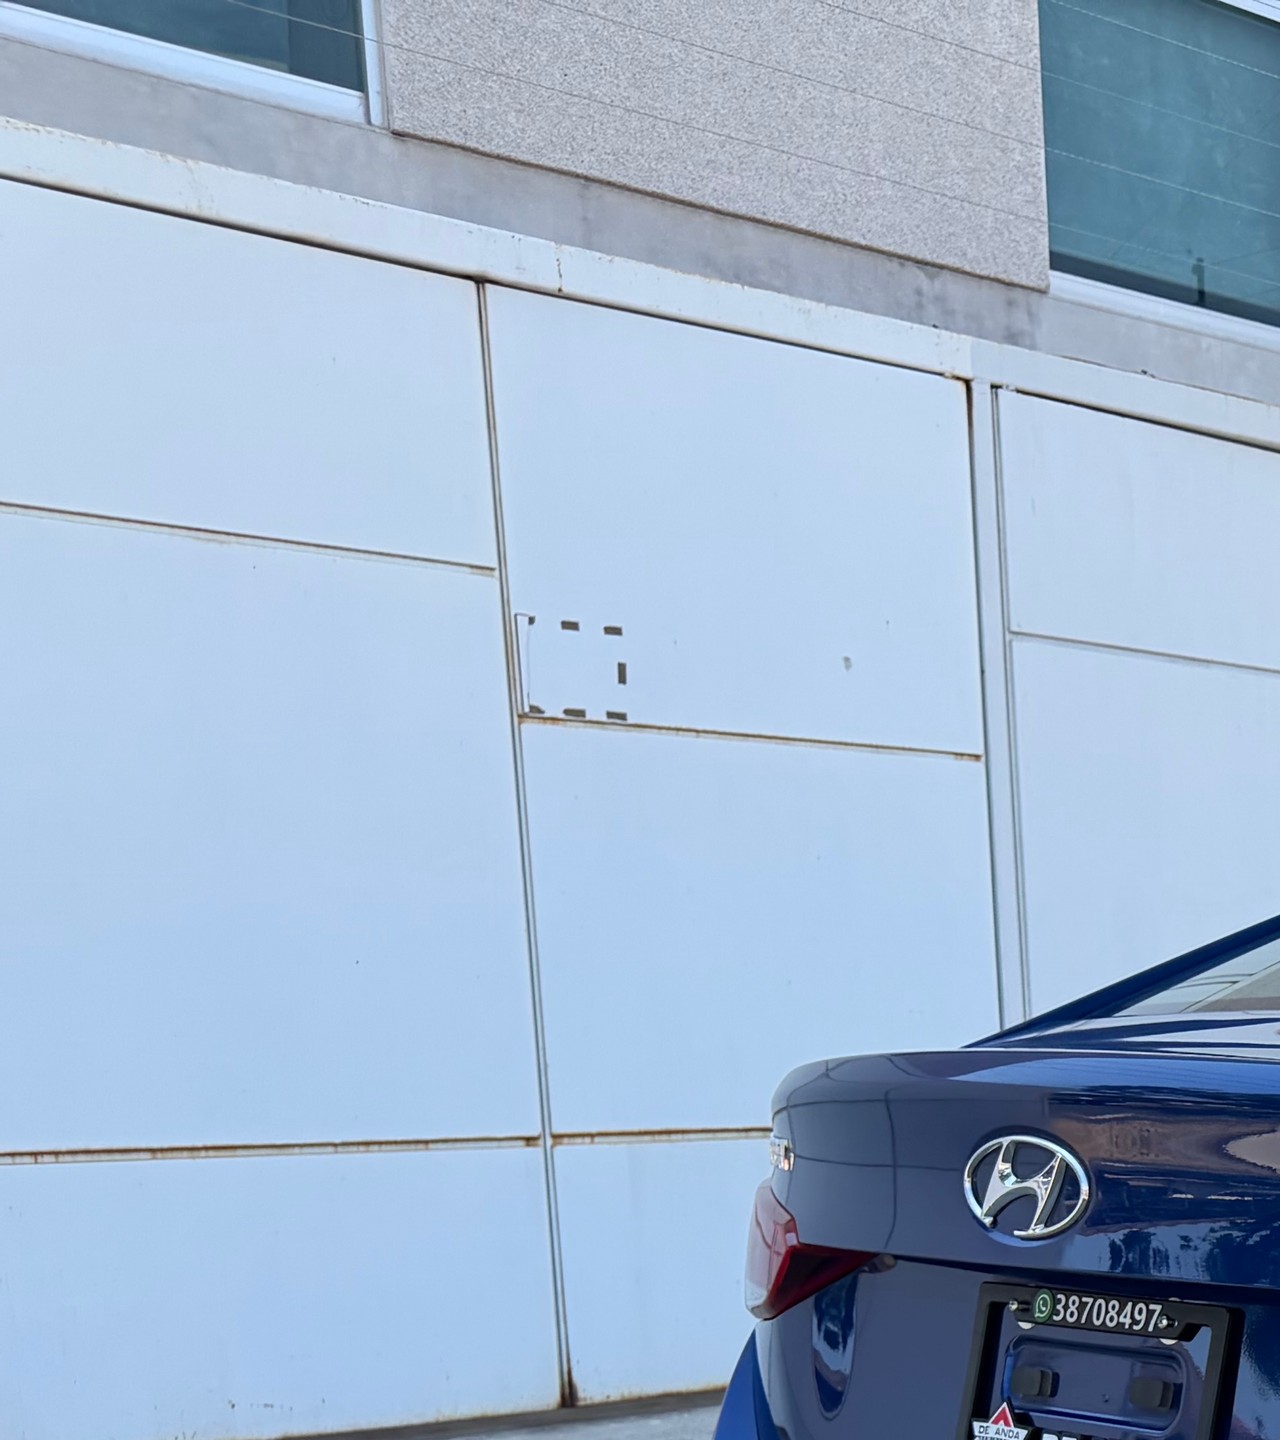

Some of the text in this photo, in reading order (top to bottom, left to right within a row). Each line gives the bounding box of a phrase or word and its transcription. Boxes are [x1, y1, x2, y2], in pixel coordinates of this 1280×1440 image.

[1052, 1294, 1162, 1332] 38708497
[978, 1425, 1020, 1440] DE ANDA
